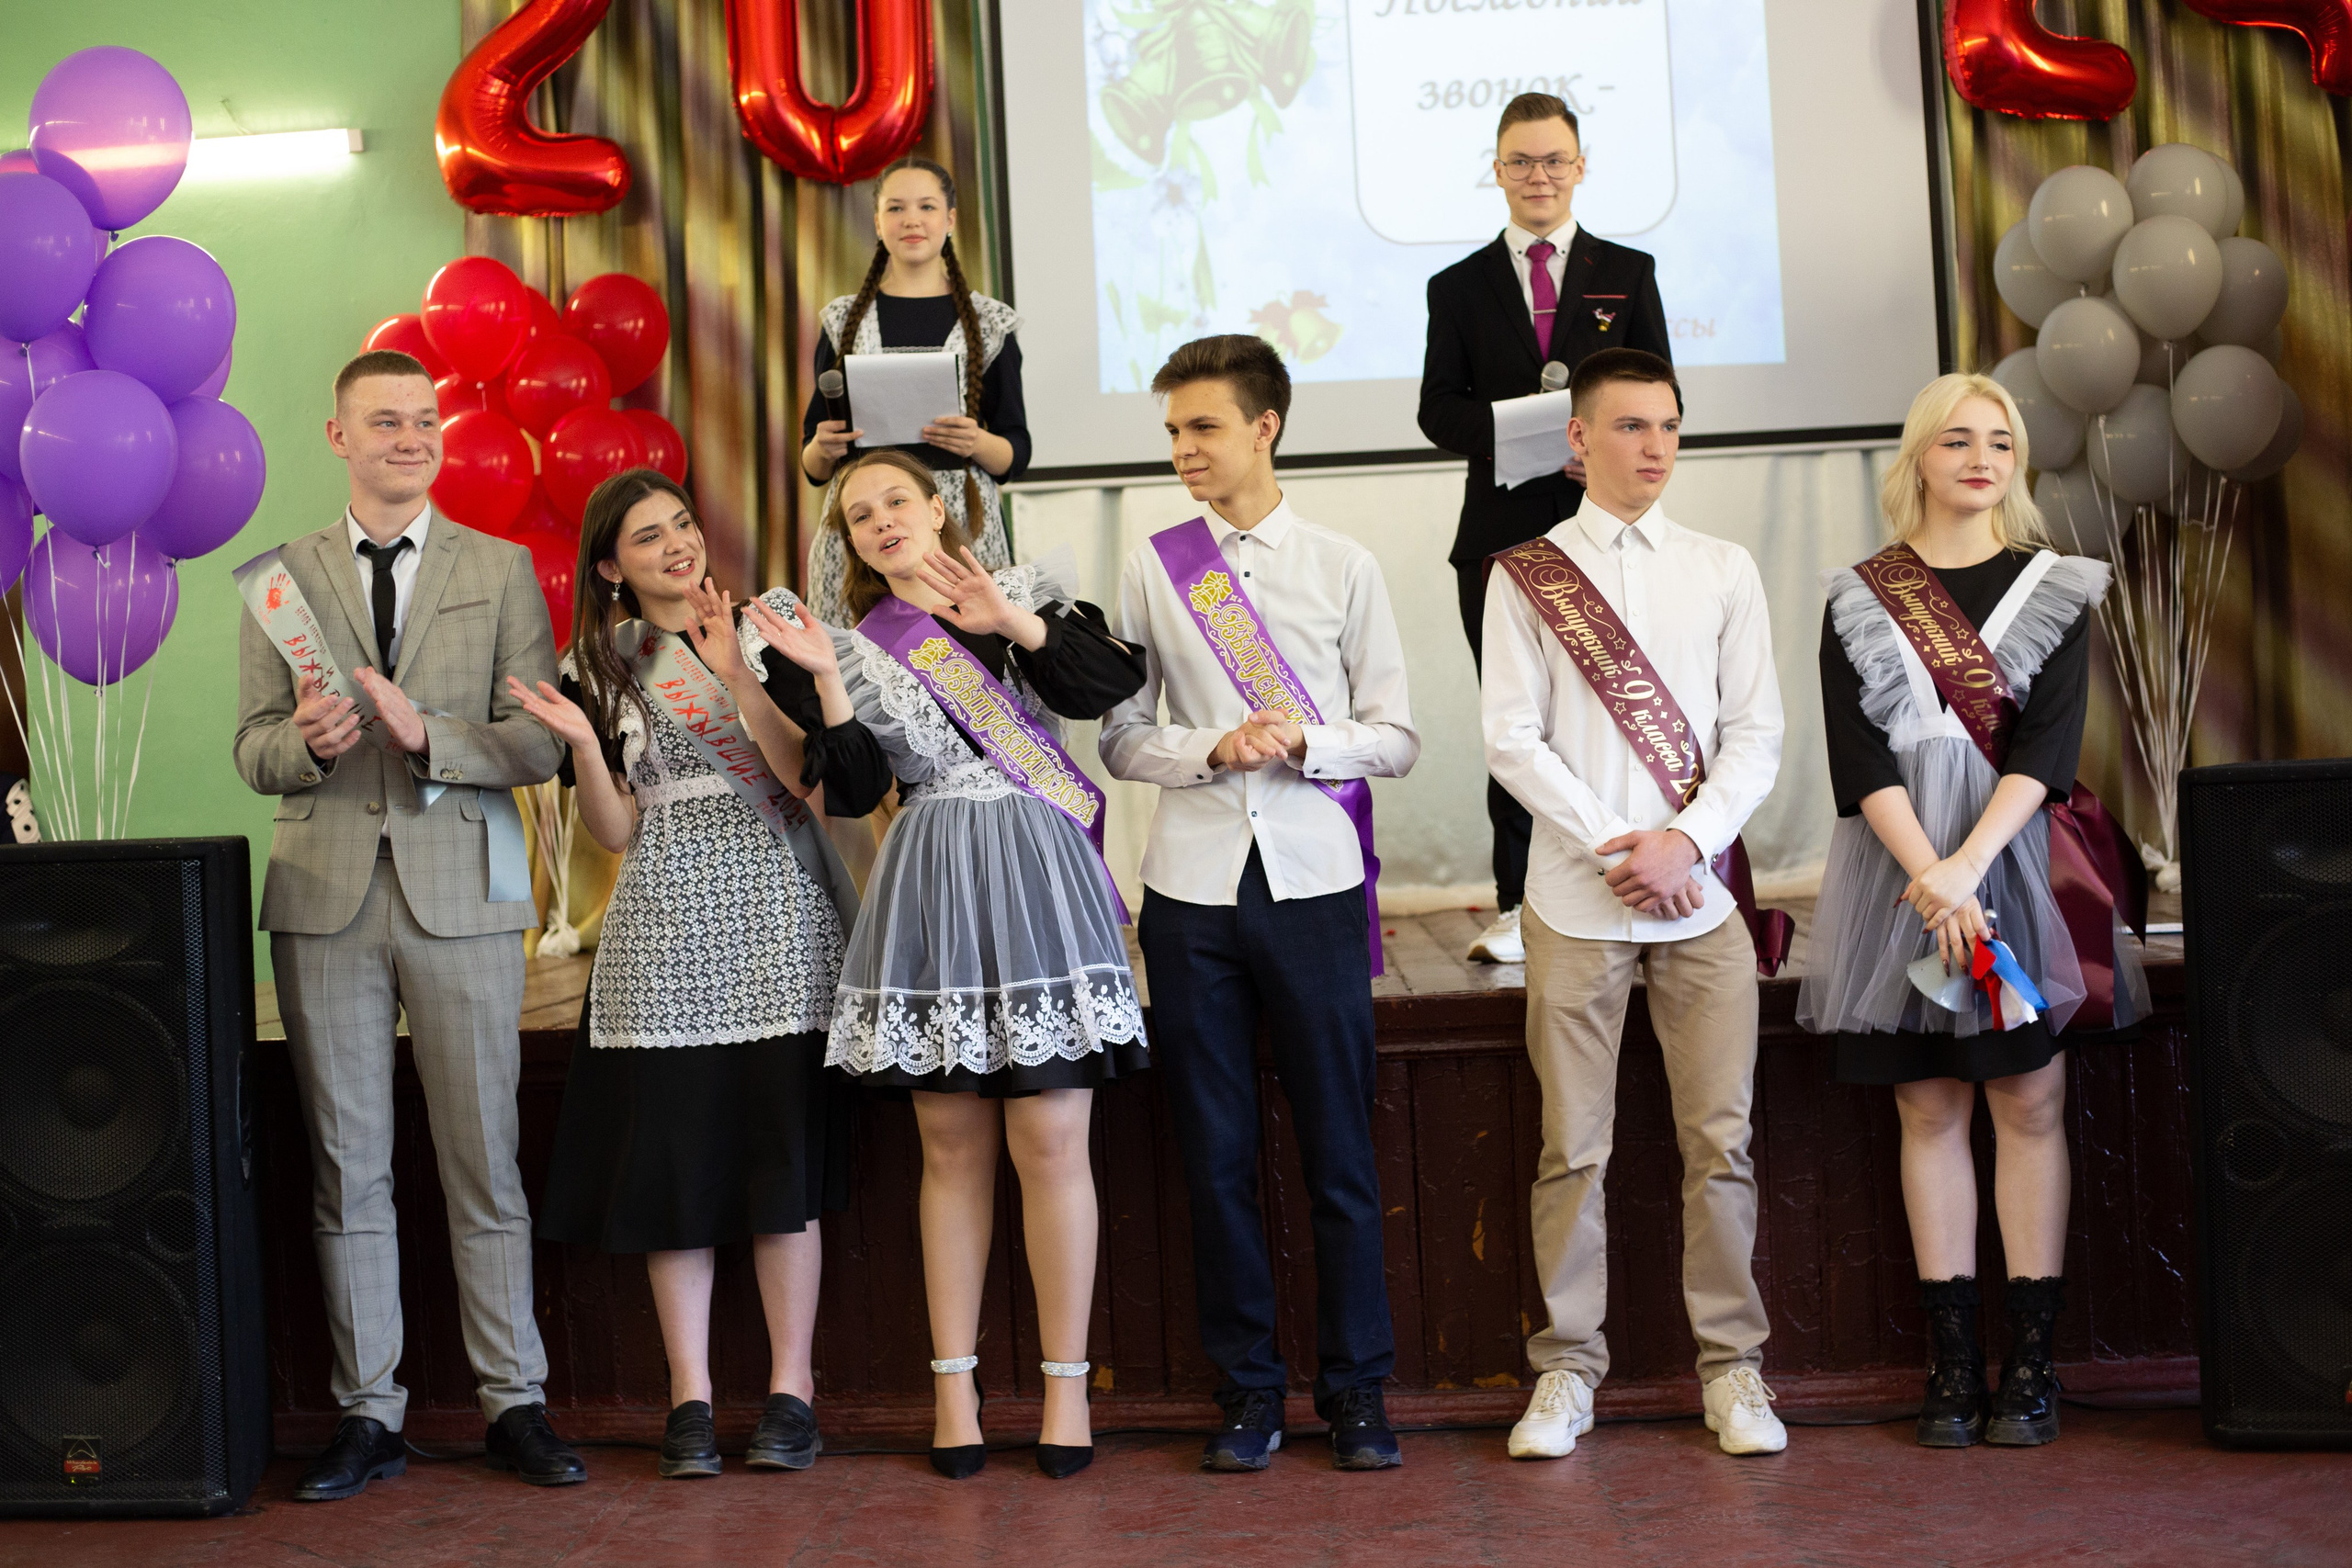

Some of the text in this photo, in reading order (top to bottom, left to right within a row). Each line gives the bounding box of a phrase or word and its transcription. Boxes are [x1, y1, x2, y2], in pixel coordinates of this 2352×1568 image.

[1529, 563, 1623, 679] Выпускник
[1606, 679, 1656, 700] 9
[1631, 708, 1684, 773] класса
[1946, 668, 1996, 689] 9
[1043, 771, 1099, 829] 2024
